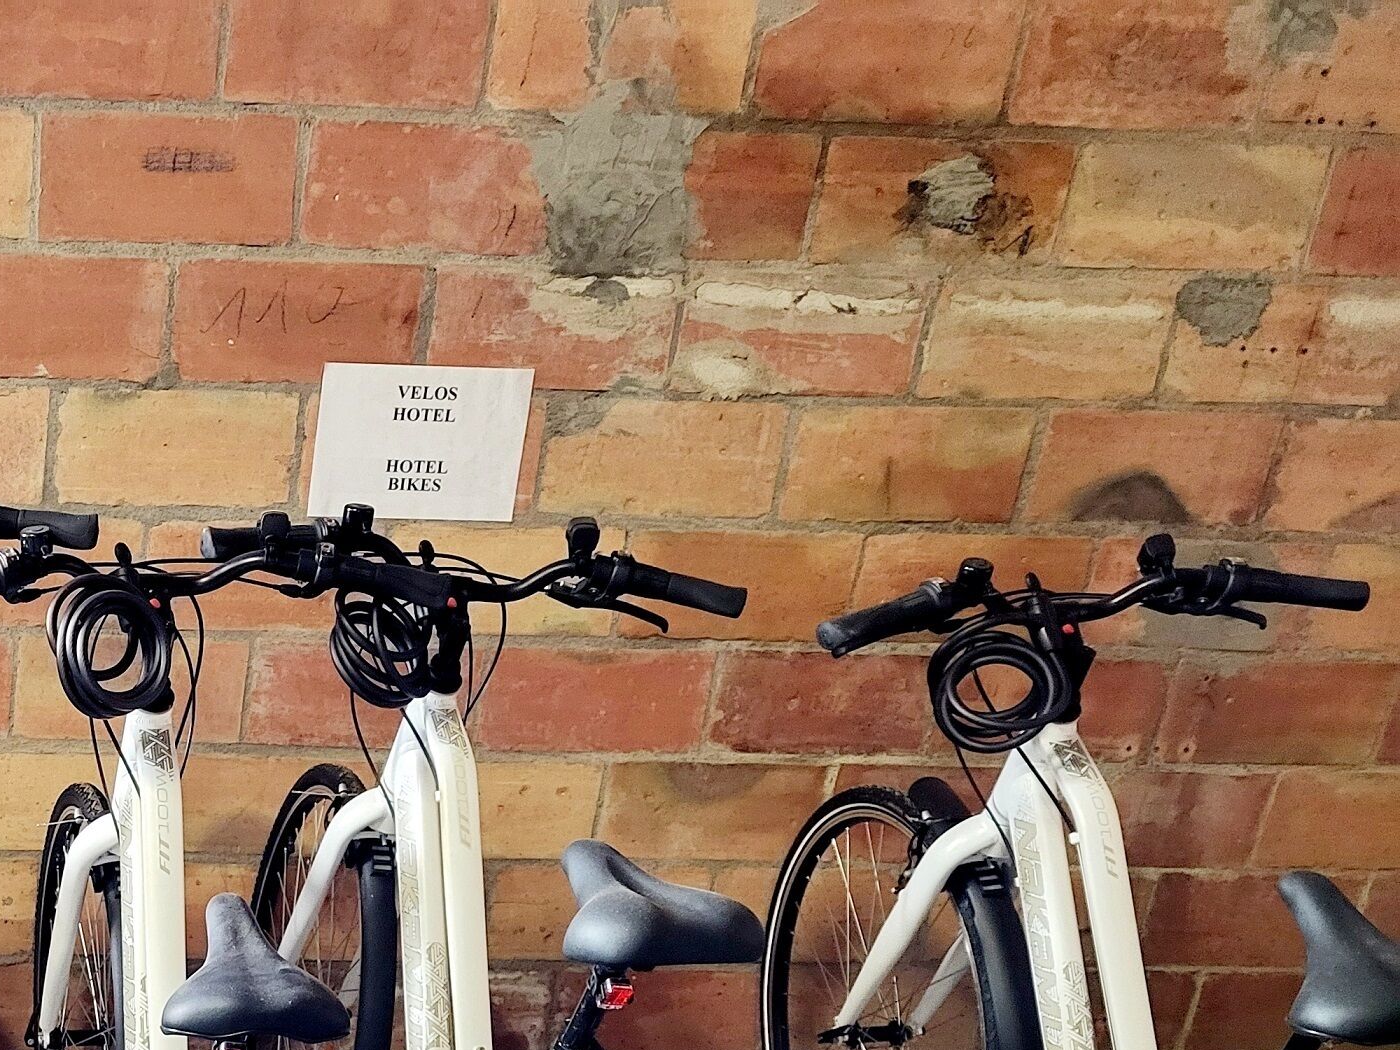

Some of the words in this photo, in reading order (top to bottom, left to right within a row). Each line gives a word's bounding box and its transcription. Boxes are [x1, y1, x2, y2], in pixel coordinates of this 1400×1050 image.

[398, 385, 459, 401] VELOS
[393, 407, 456, 422] HOTEL
[386, 459, 448, 474] HOTEL
[388, 477, 442, 492] BIKES
